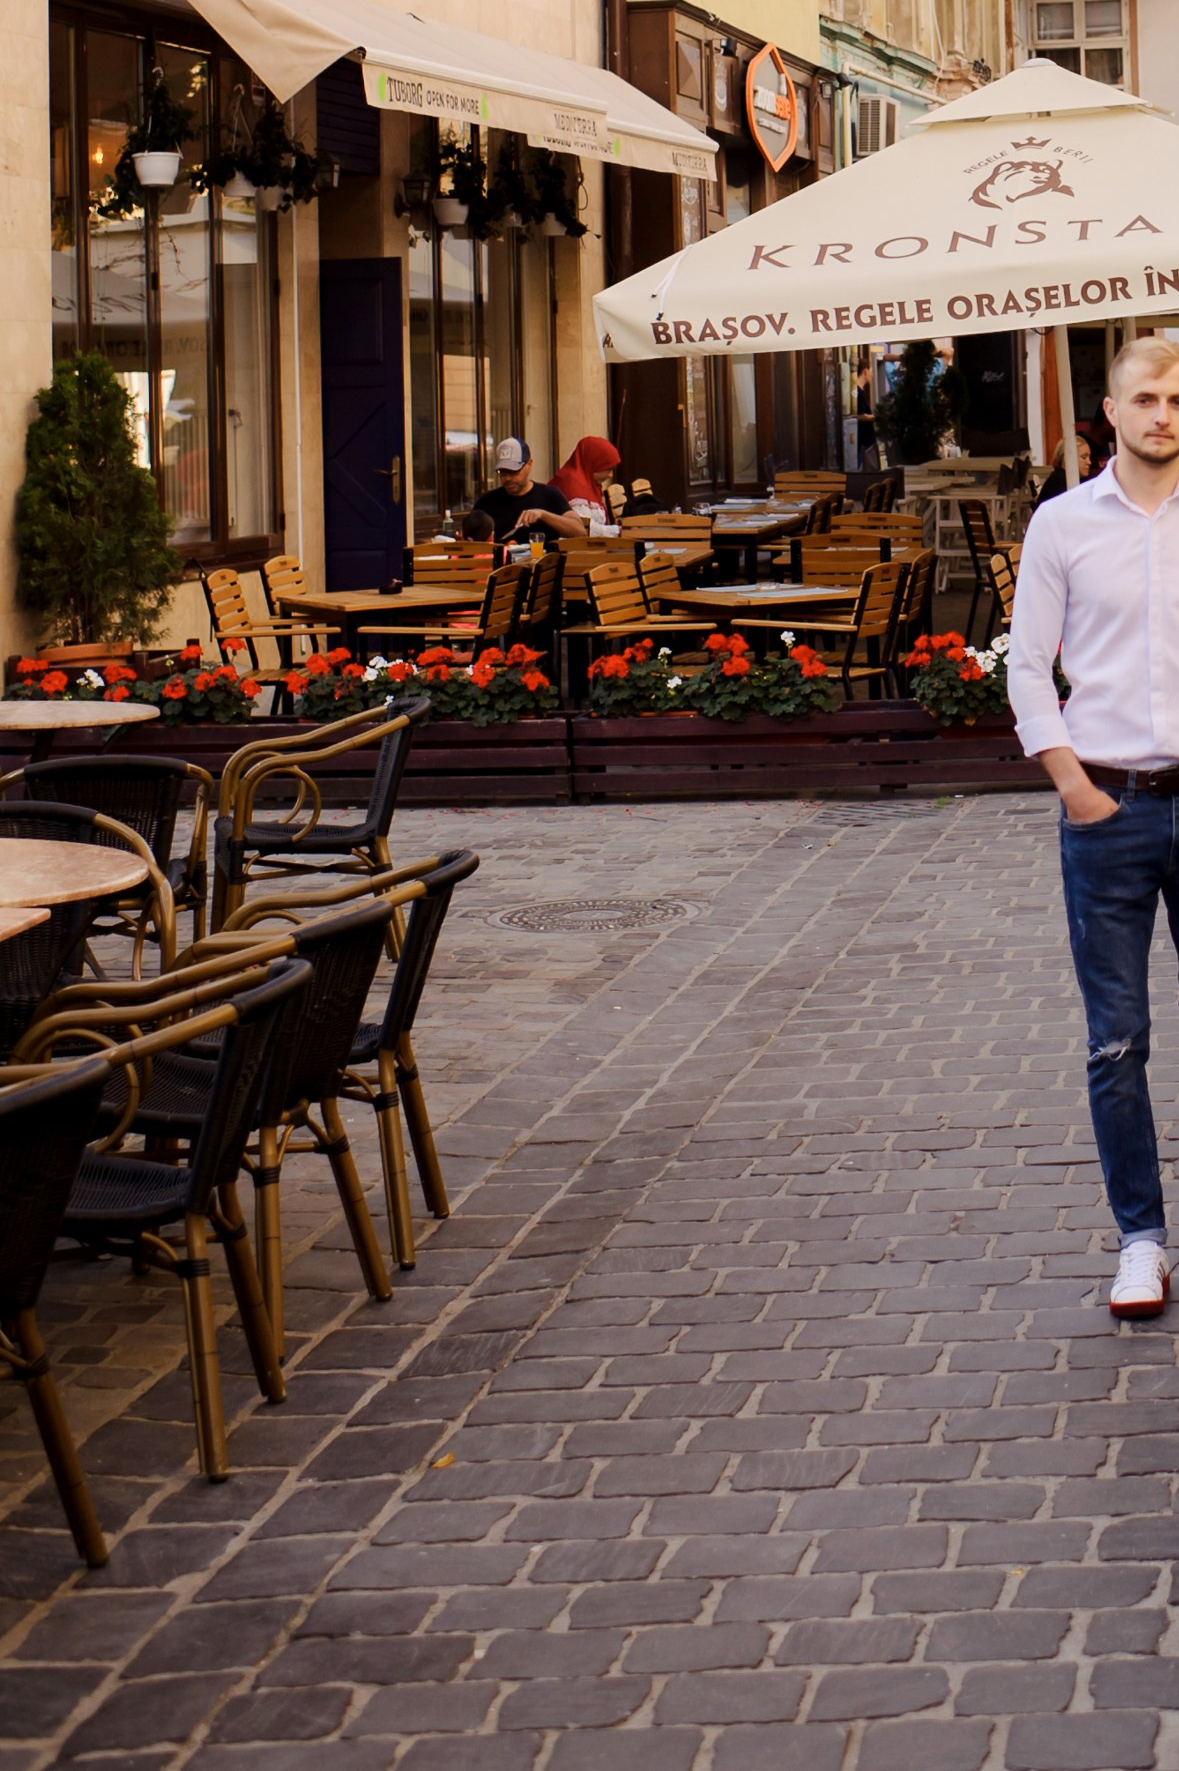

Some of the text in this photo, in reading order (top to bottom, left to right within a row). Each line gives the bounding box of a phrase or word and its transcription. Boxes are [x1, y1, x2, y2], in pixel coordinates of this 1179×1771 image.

[387, 77, 479, 115] TUBORG OPEN FOR MORE
[554, 113, 598, 137] MEDITERRA
[963, 147, 1093, 174] REGELE BERII
[651, 312, 795, 346] BRAȘOV.
[810, 299, 933, 333] REGELE
[947, 275, 1133, 318] ORAȘELOR
